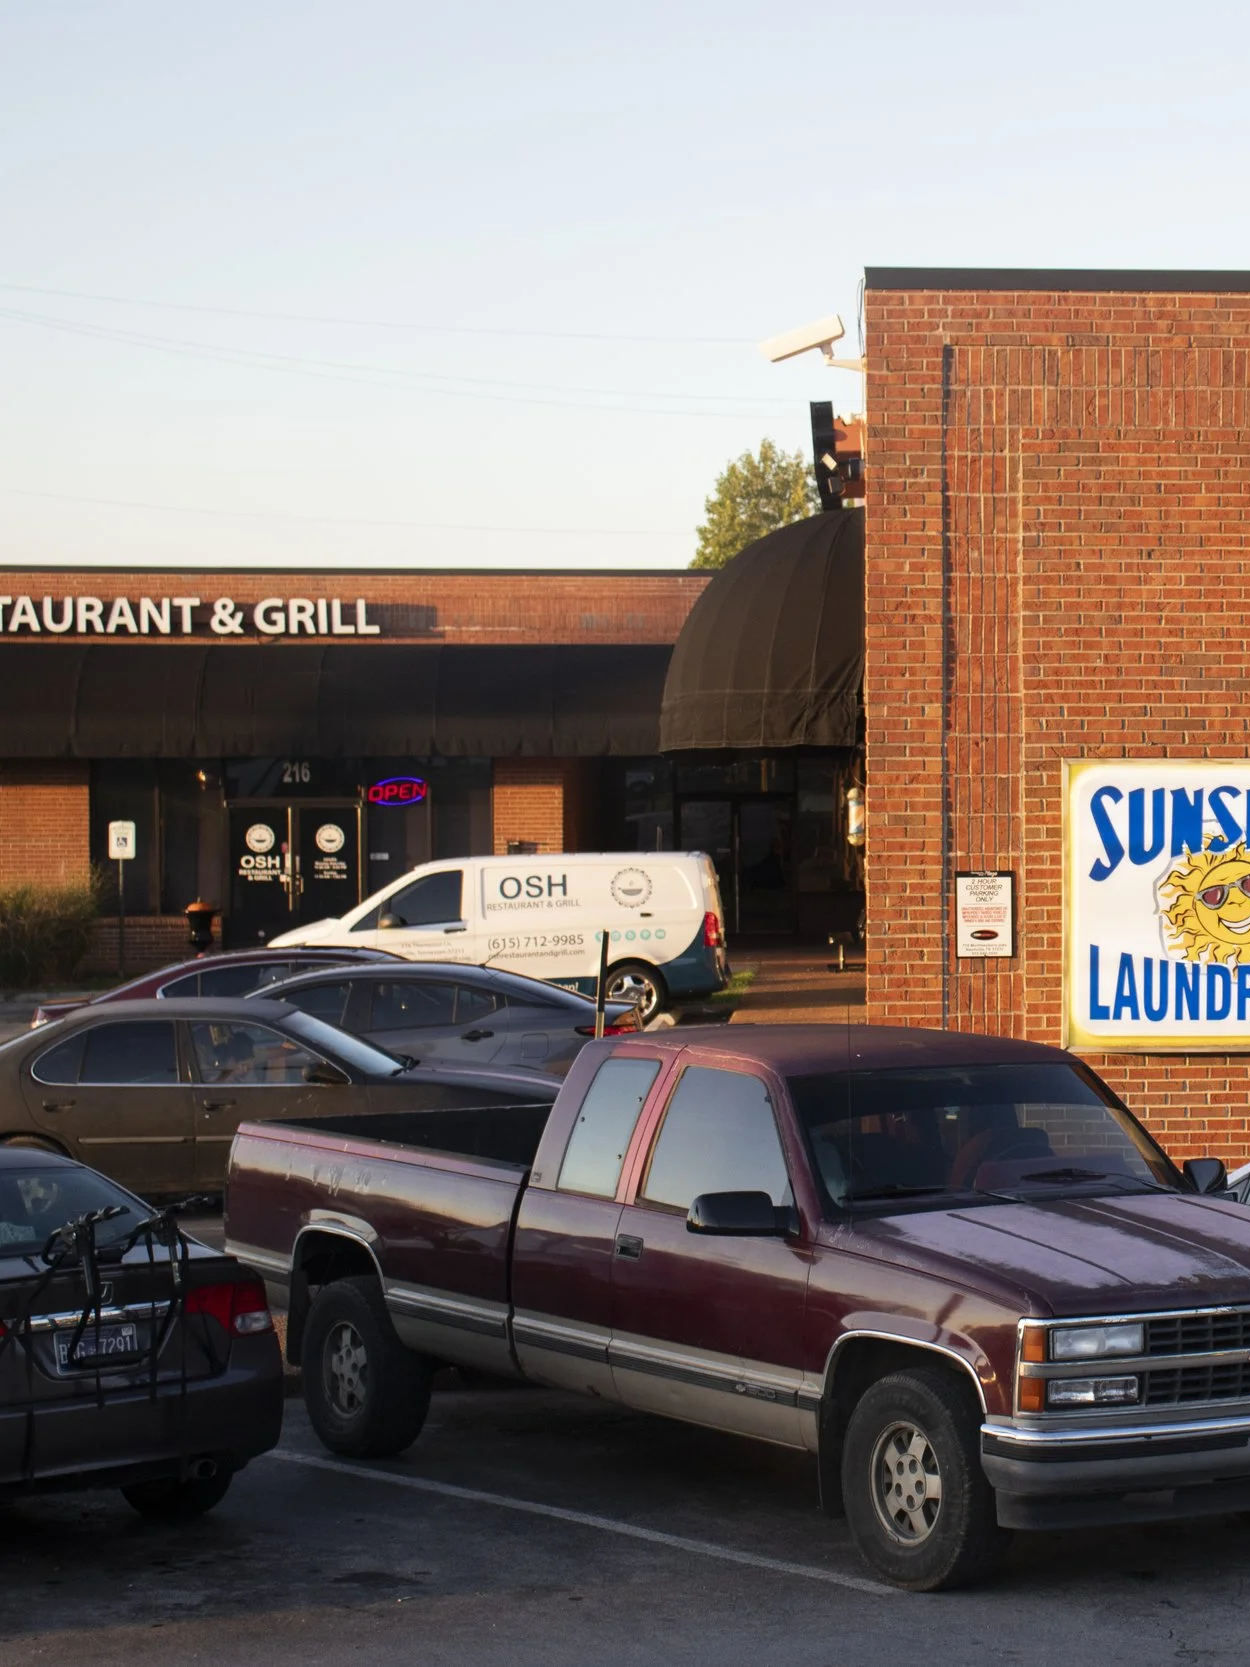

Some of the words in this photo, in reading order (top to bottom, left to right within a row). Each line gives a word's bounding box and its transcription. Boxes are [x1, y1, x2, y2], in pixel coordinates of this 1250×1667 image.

[210, 599, 244, 634] &
[253, 598, 380, 635] GRILL
[283, 763, 310, 783] 216
[368, 783, 427, 802] OPEN
[240, 855, 281, 869] OSH
[499, 874, 567, 899] OSH
[487, 901, 545, 912] RESTAURANT
[546, 899, 553, 908] &
[555, 899, 581, 908] GRILL
[488, 936, 520, 951] (615)
[524, 934, 584, 948] 712-9985
